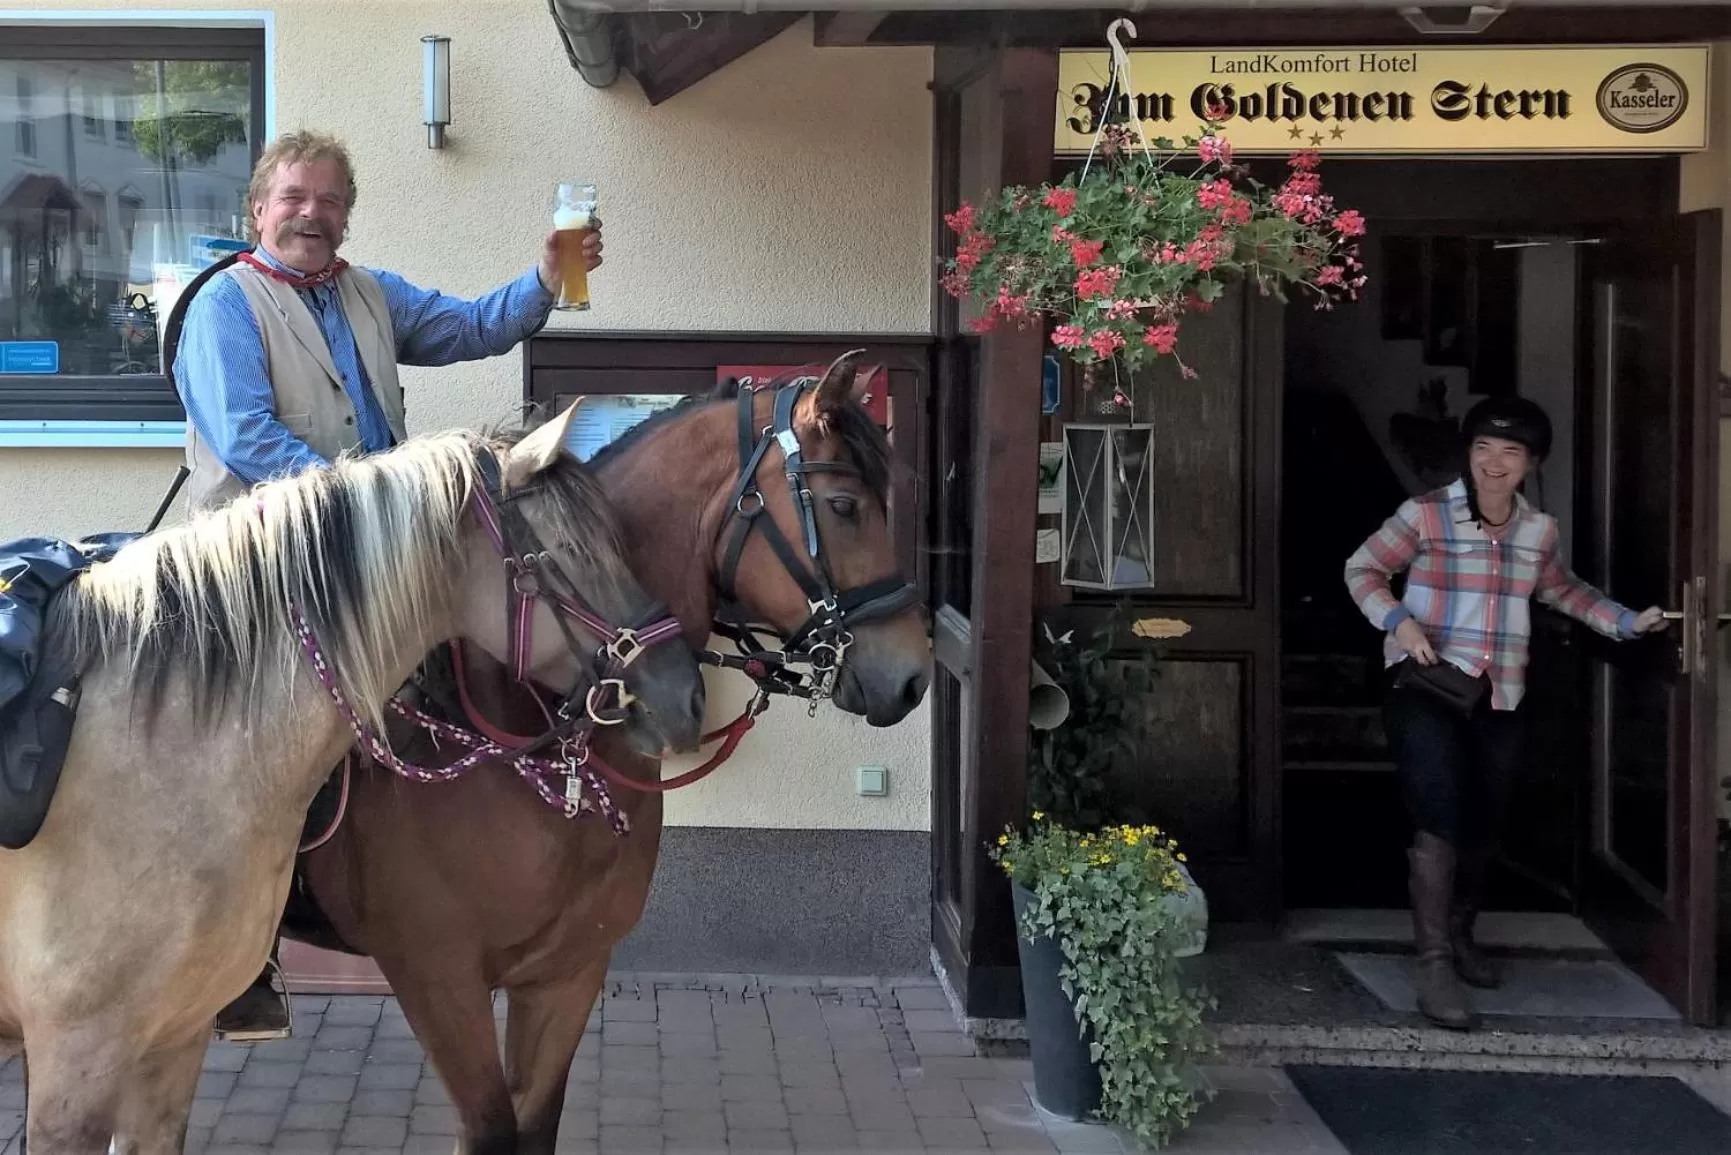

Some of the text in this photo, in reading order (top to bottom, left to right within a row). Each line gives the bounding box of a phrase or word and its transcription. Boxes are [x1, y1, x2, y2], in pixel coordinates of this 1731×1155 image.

[1211, 53, 1418, 73] LandKomfort Hotel
[1190, 81, 1415, 123] Goldenen
[1430, 80, 1573, 122] Stern
[1610, 89, 1676, 108] Kasseler
